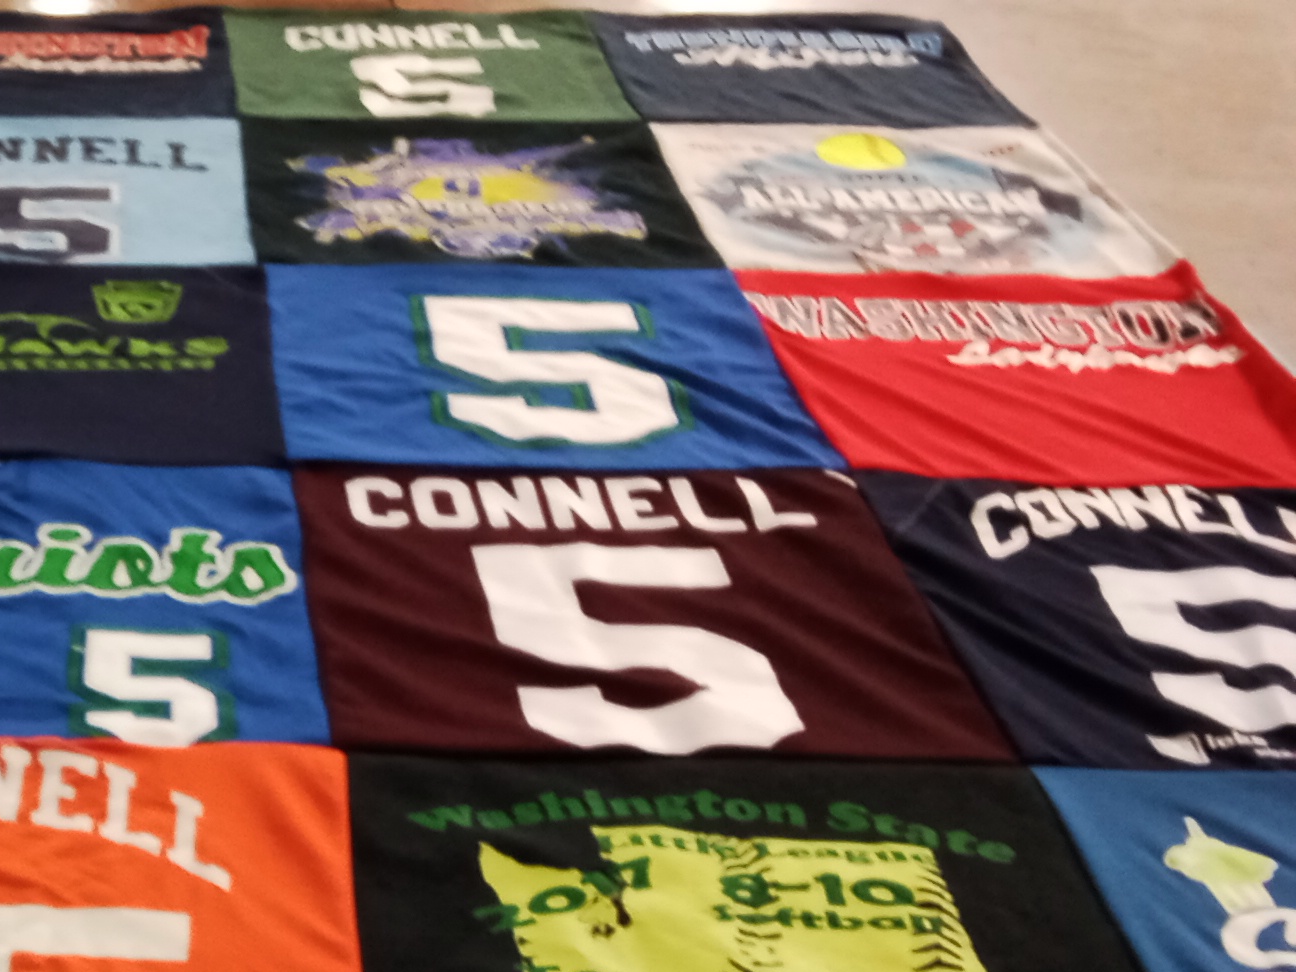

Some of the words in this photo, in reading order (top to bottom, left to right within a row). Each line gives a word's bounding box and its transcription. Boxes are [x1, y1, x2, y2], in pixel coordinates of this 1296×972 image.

[284, 22, 540, 52] CONNELL
[744, 291, 1223, 351] WASHINGTON
[410, 295, 695, 447] 5
[344, 475, 818, 533] CONNELL
[72, 627, 237, 748] 5
[470, 541, 806, 756] 5
[1089, 564, 1296, 733] 5
[407, 788, 807, 831] Washington
[825, 800, 1017, 864] State
